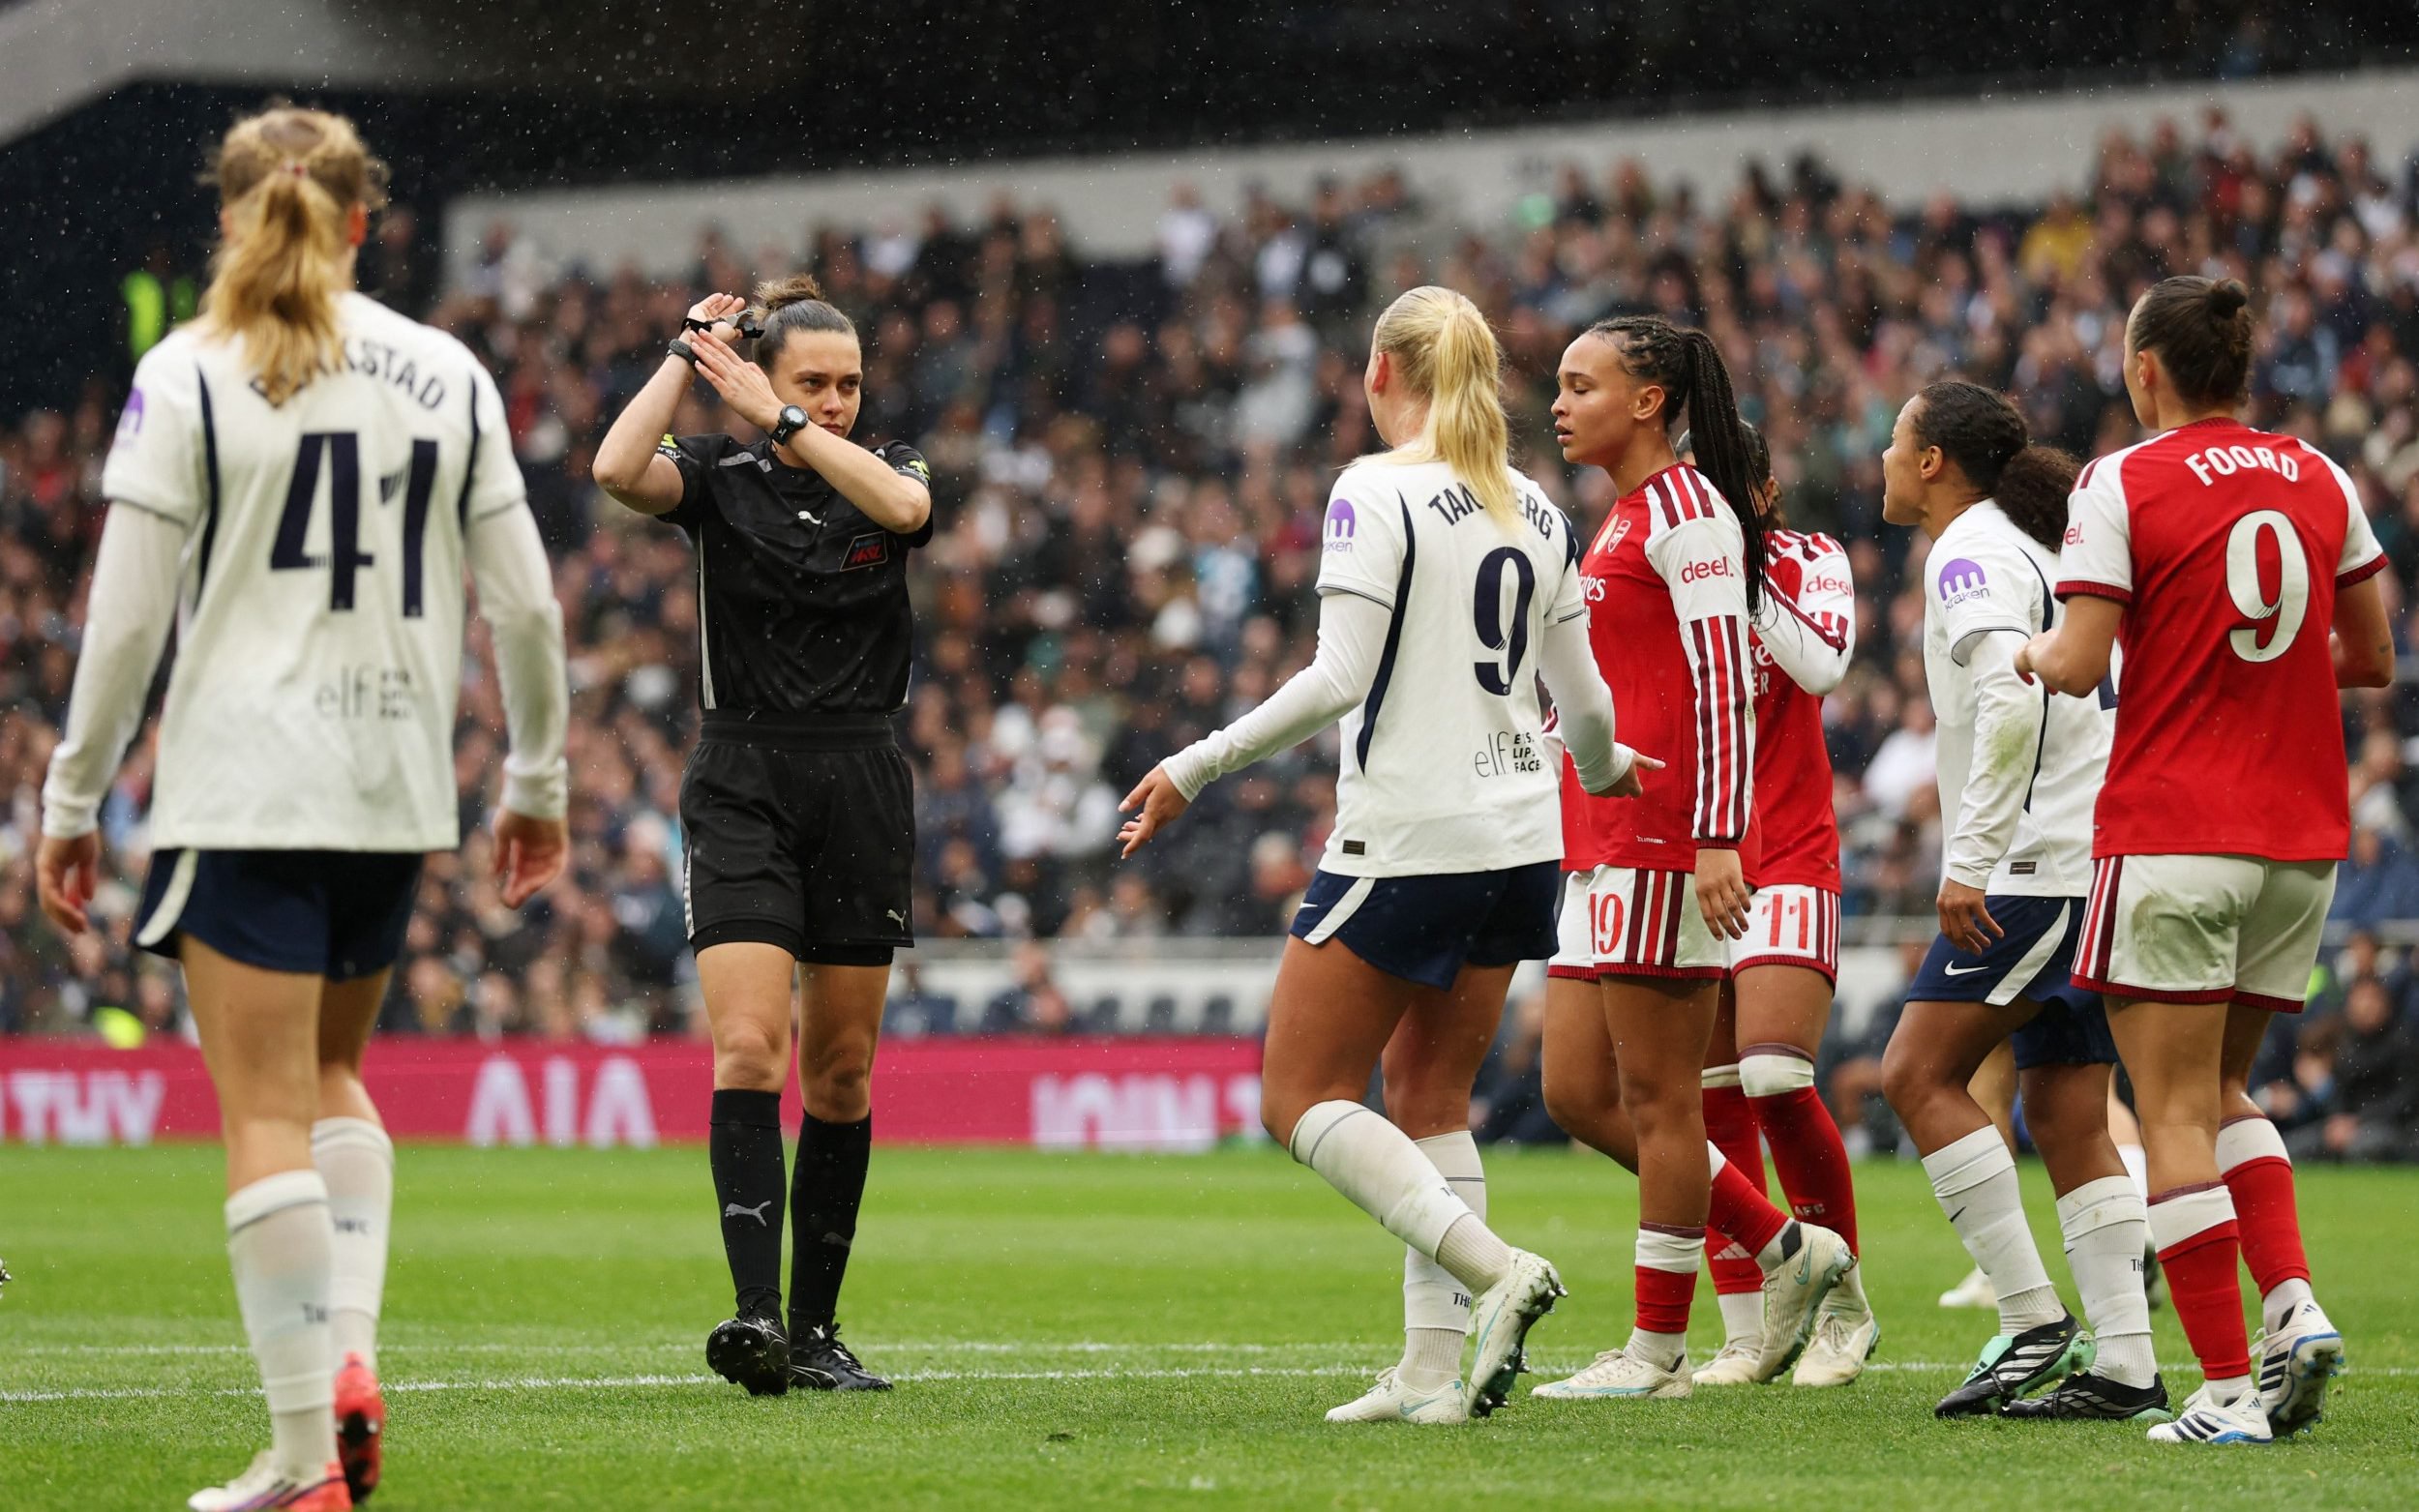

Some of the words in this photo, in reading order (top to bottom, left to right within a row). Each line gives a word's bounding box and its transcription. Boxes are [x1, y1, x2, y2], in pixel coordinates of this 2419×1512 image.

[2185, 445, 2299, 487] FOORD
[270, 431, 438, 619] 41
[1427, 482, 1553, 541] TANERG
[1681, 555, 1734, 584] deel.
[2225, 509, 2310, 664] 9
[1474, 546, 1536, 697] 9
[1945, 587, 1990, 612] kraken
[1761, 894, 1808, 950] 11
[463, 1052, 661, 1150] AIA
